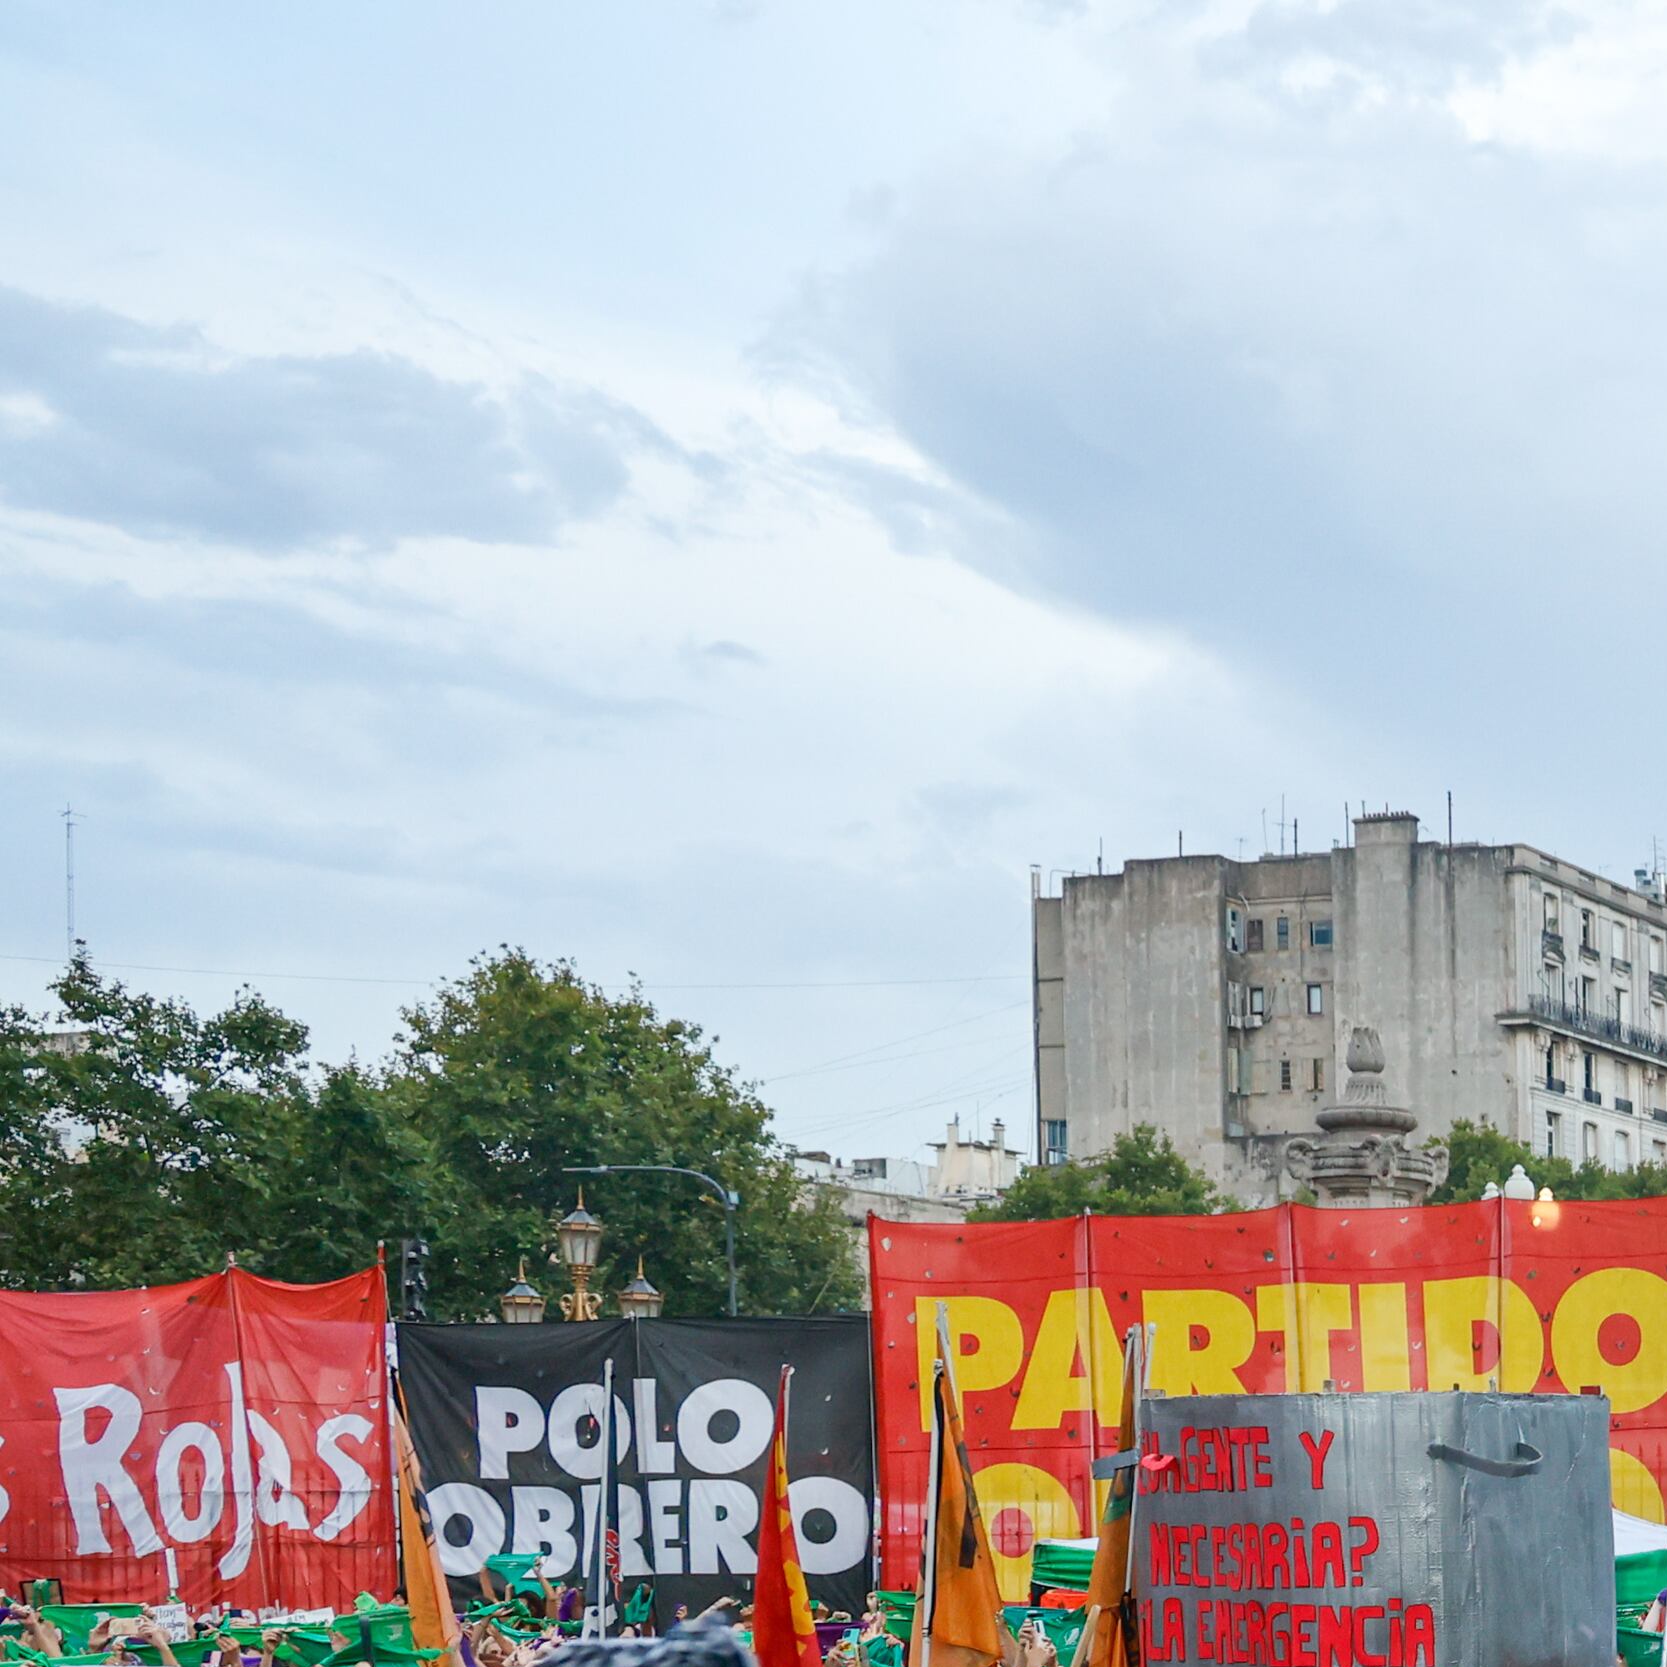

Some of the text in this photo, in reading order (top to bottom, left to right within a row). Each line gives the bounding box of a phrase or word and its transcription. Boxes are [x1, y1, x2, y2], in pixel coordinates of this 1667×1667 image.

[477, 1378, 775, 1480] POLO
[1298, 1429, 1335, 1490] Y
[427, 1475, 869, 1577] OBRERO
